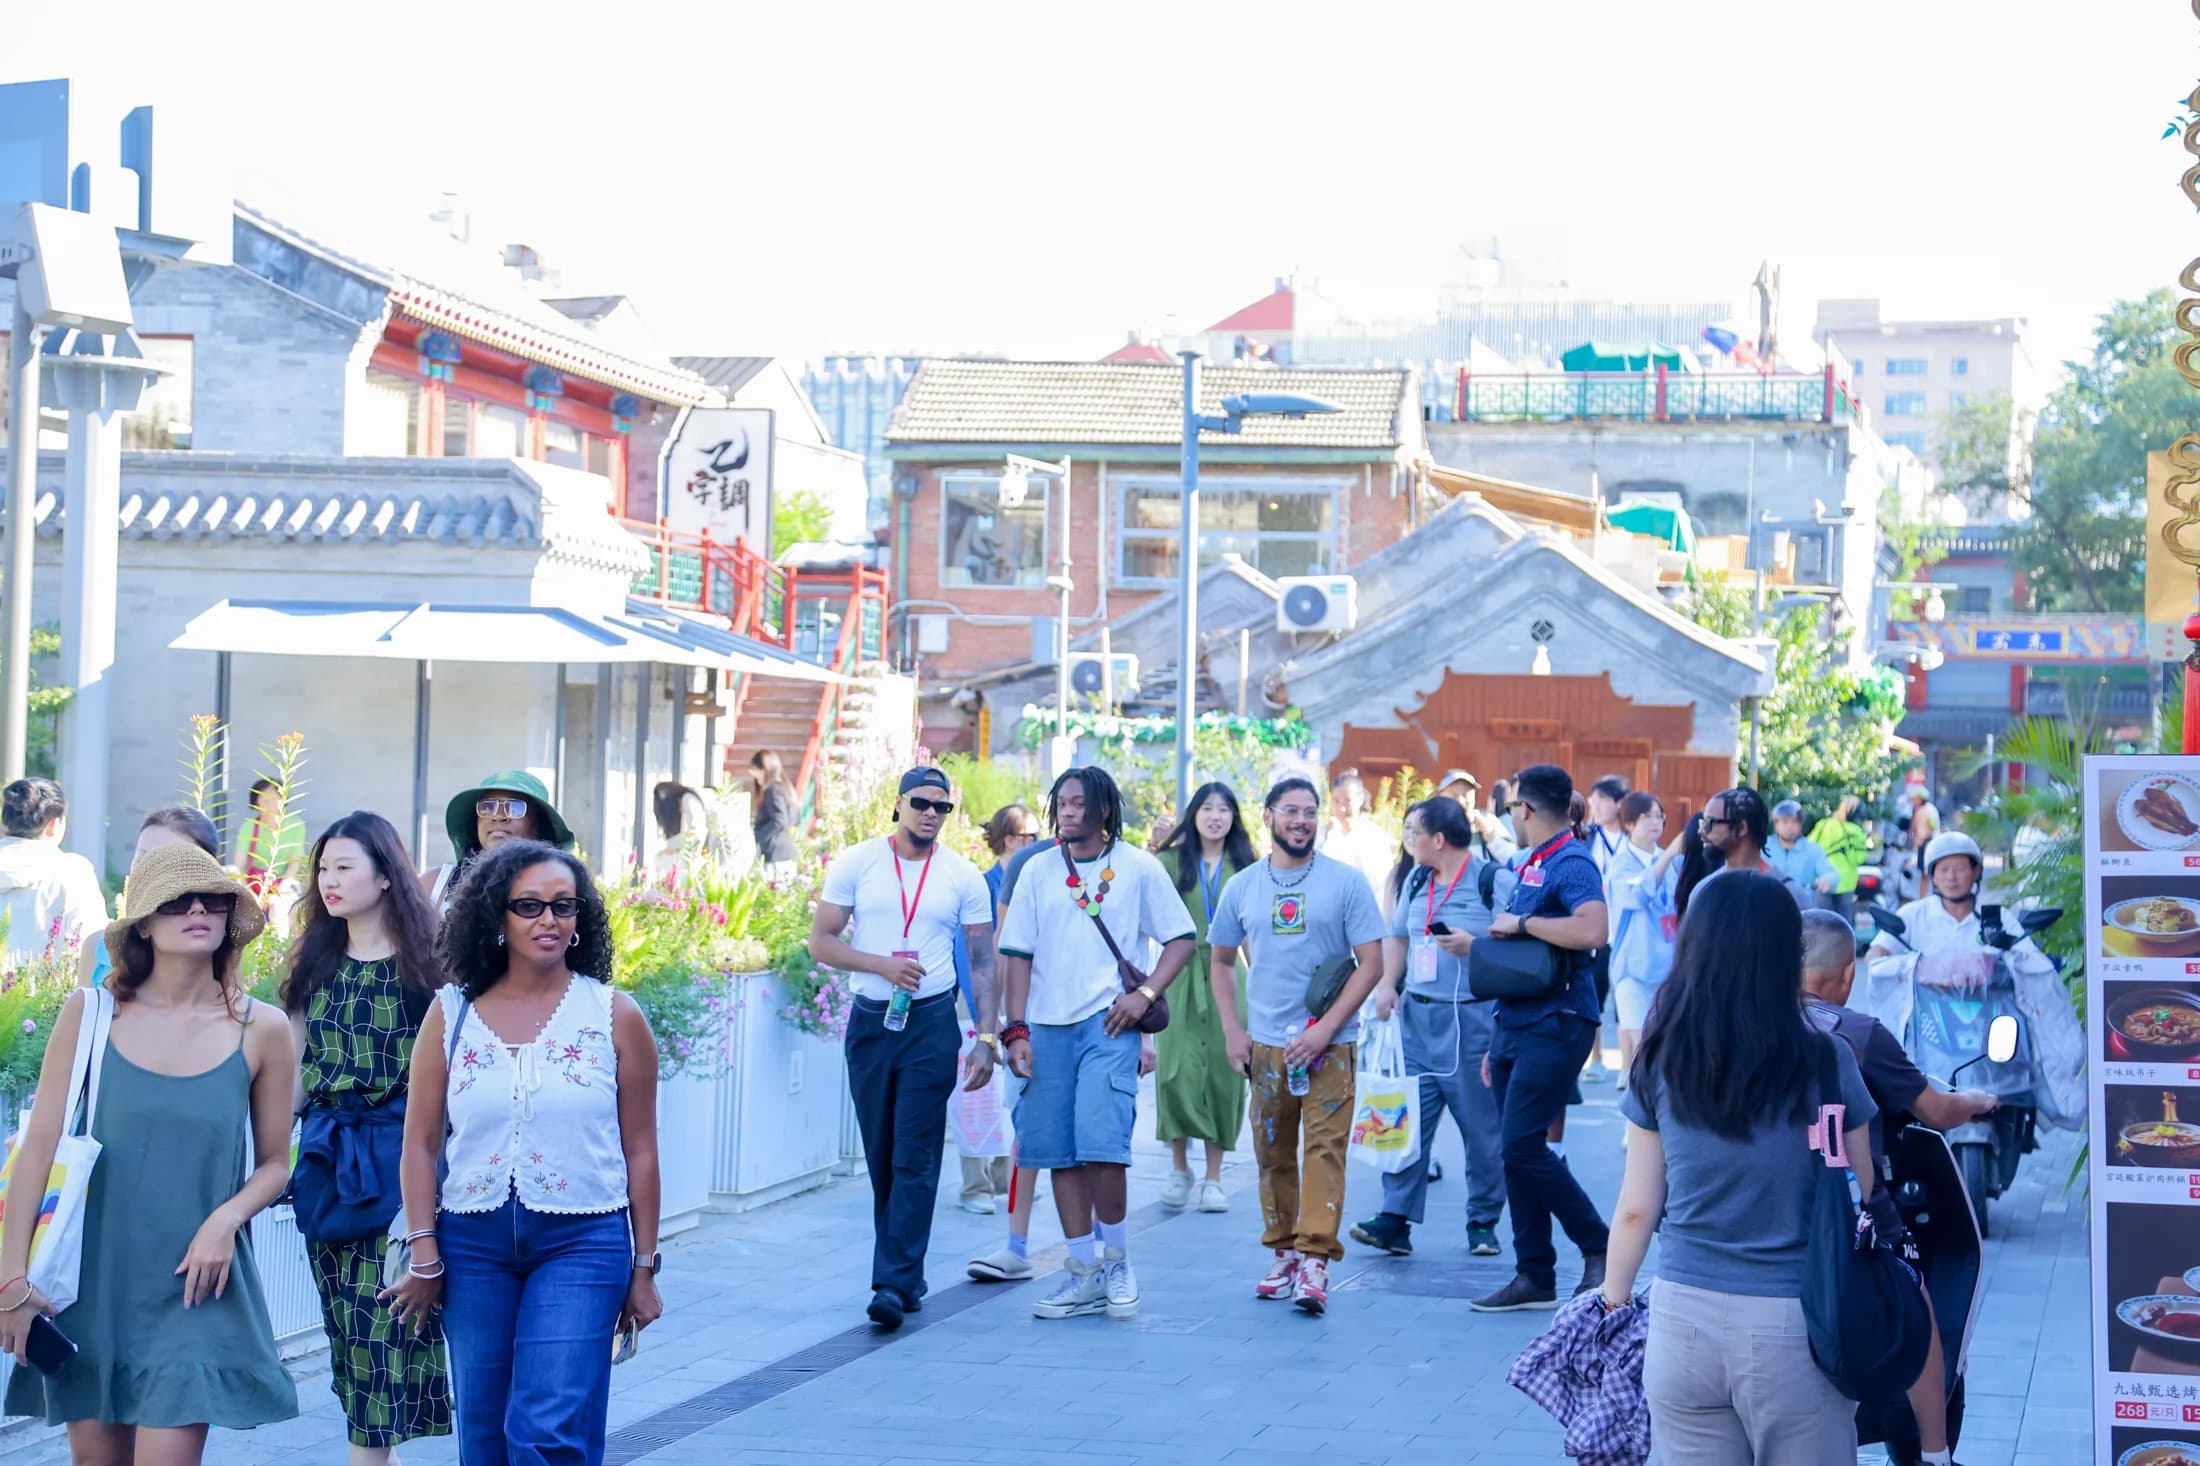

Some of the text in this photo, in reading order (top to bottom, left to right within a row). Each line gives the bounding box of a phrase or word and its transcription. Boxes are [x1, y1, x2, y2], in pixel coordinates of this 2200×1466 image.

[2114, 1382, 2199, 1400] 九城甄选烤
[2117, 1403, 2145, 1417] 268
